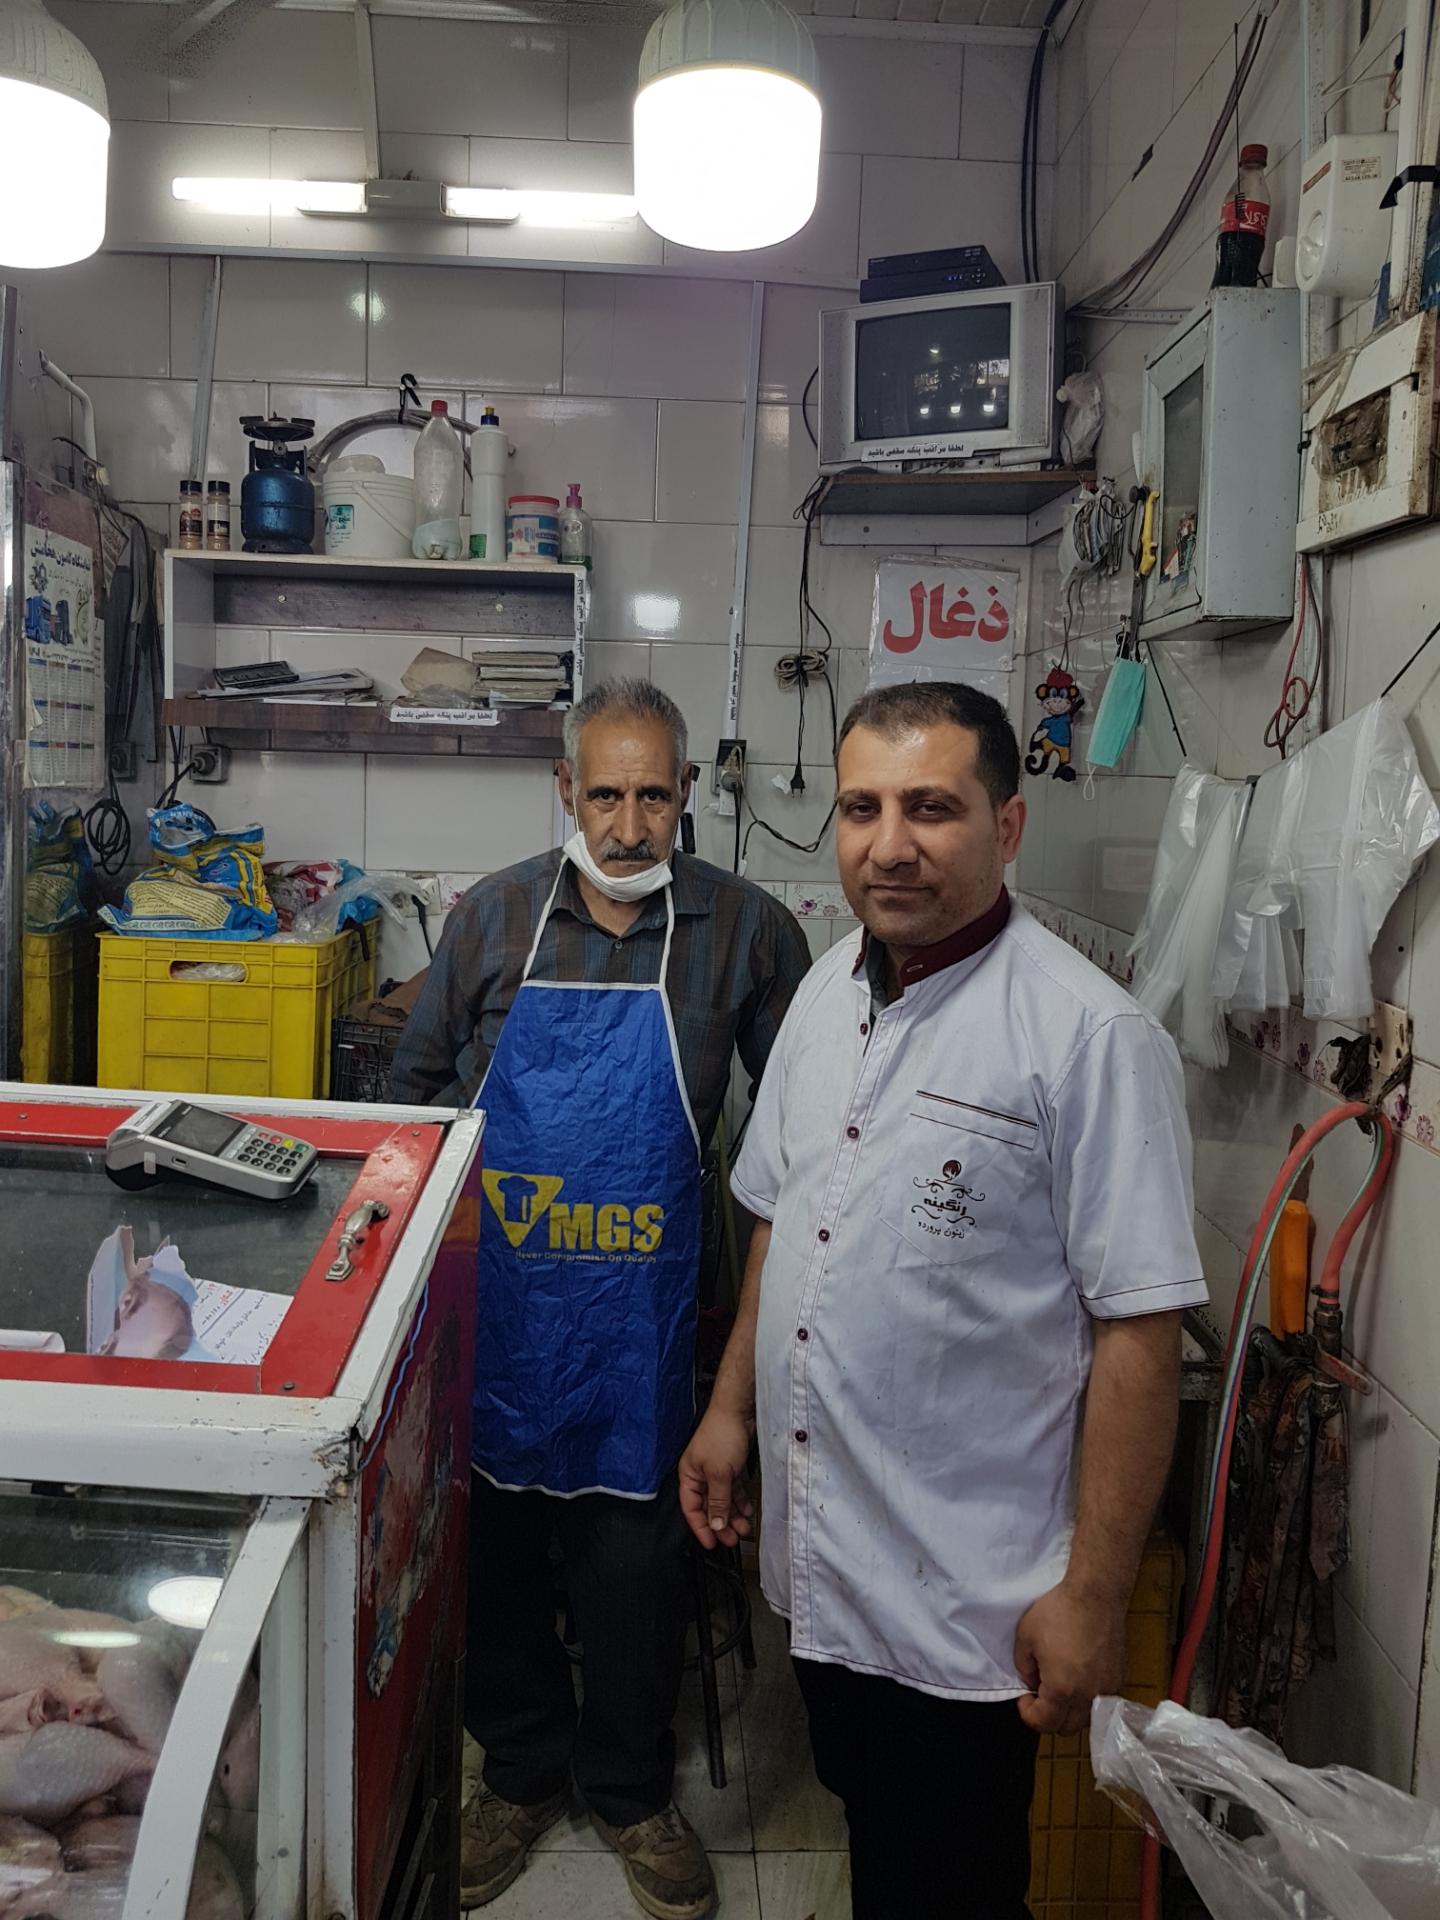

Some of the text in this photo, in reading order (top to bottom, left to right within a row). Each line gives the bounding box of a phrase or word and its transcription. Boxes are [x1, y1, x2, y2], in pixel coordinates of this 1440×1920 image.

[868, 444, 964, 457] لطفا مراقب پنکه سقفی باشید
[883, 581, 1009, 654] ذغال
[396, 711, 414, 720] باشید
[416, 712, 434, 720] سقفی
[437, 711, 451, 720] پنکه
[923, 1196, 967, 1216] رنگینه
[550, 1203, 664, 1252] MGS
[918, 1221, 941, 1236] پرورده
[515, 1251, 657, 1263] Never Compromise On Quality
